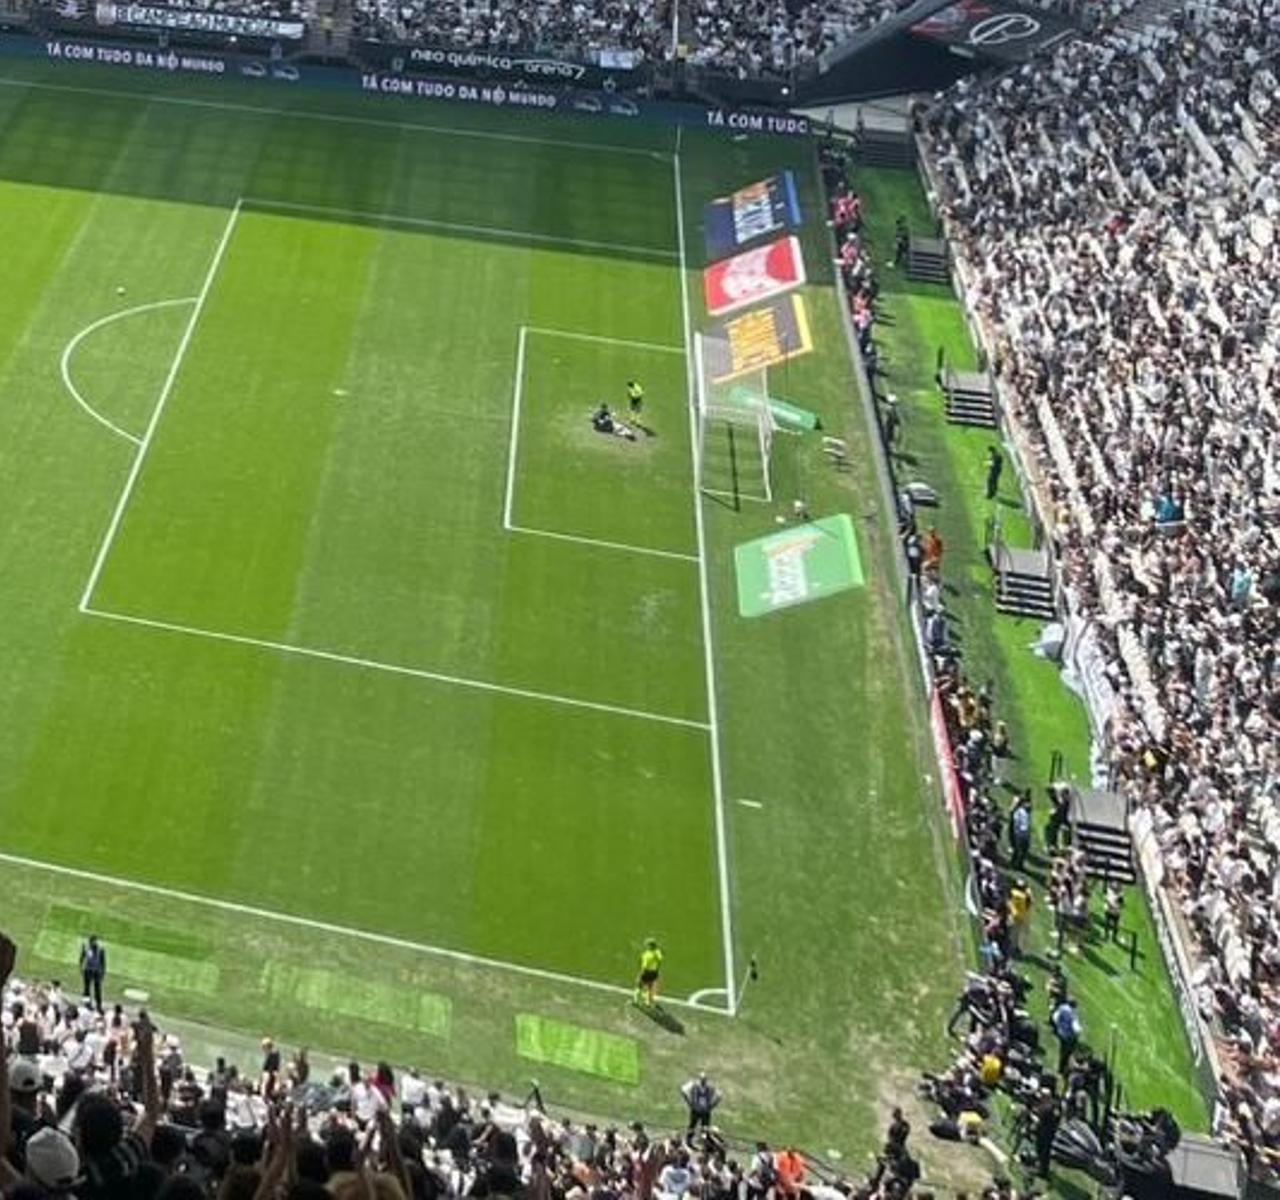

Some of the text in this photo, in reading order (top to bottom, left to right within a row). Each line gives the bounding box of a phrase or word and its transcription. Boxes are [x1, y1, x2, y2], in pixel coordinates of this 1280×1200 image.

[410, 49, 444, 63] neo
[380, 77, 412, 94] COM
[415, 80, 456, 98] TUDO
[727, 113, 763, 130] COM
